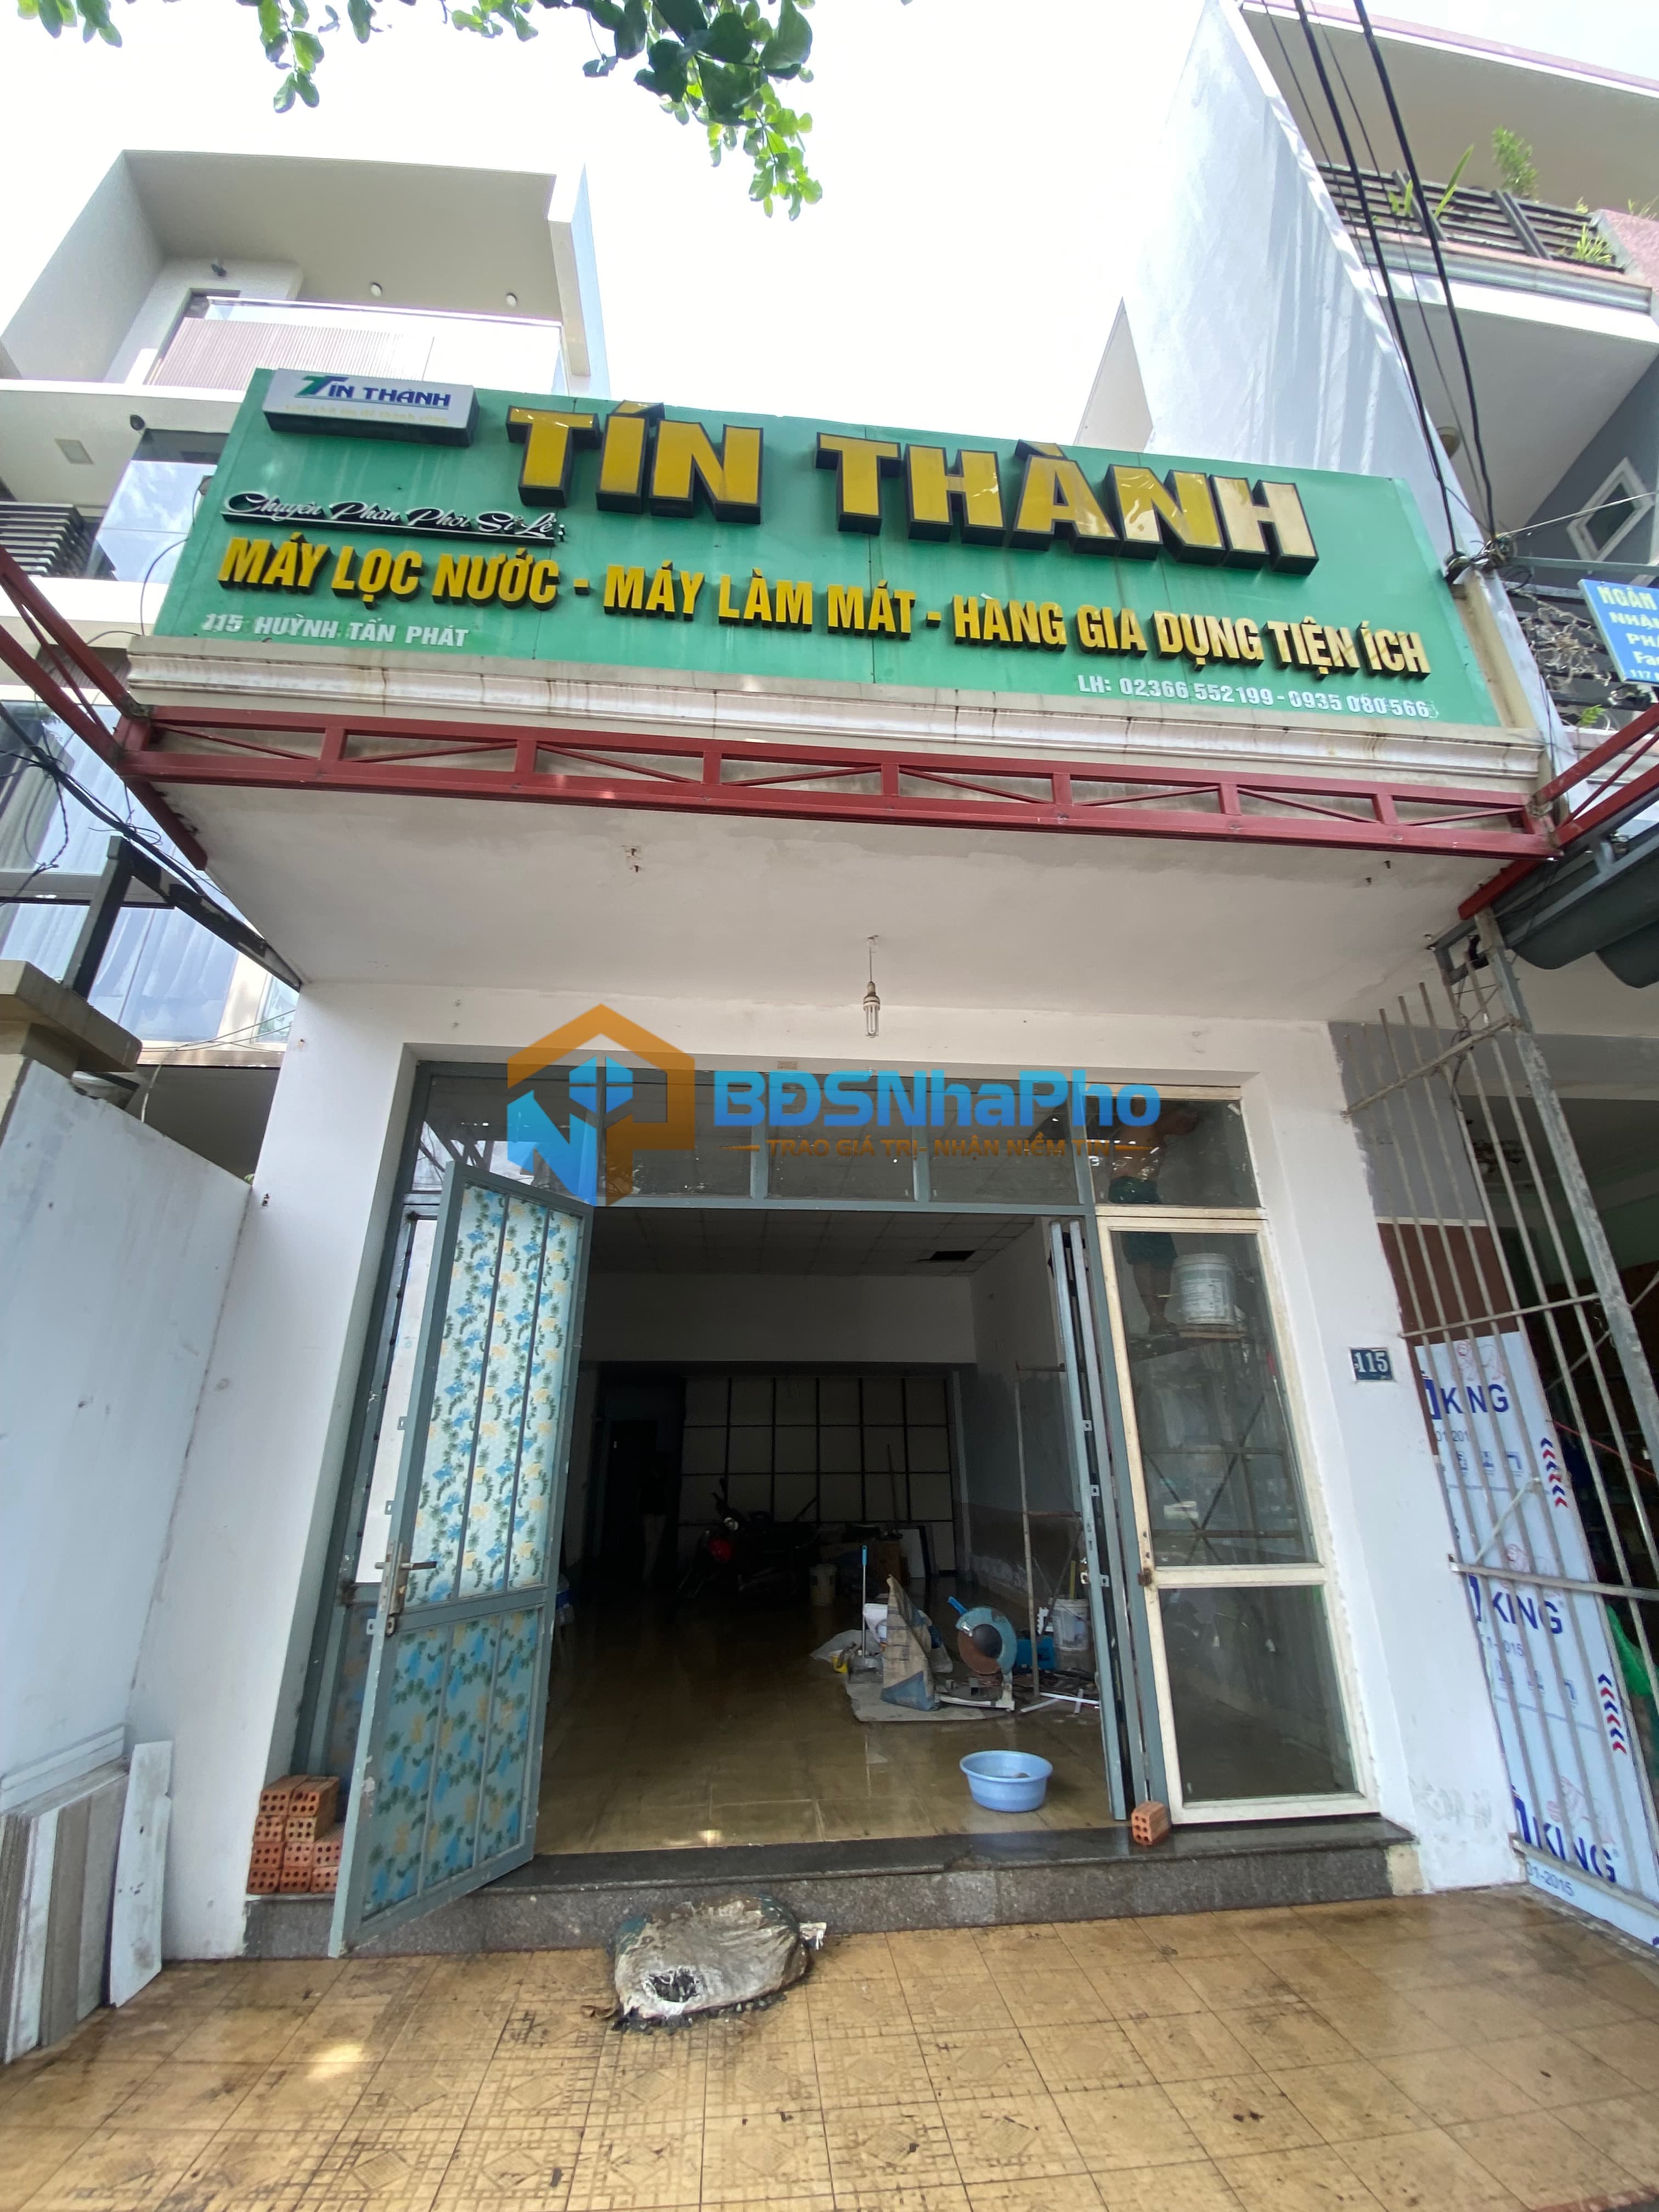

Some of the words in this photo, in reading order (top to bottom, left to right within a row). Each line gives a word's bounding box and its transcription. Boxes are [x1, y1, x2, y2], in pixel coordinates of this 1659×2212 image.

[363, 387, 451, 407] THÀNH
[506, 400, 764, 521] TÍN
[816, 431, 1319, 573] THÀNH
[223, 490, 323, 522] Chuyên
[218, 531, 329, 592] MÁY
[331, 545, 424, 607] LỌC
[431, 547, 560, 608] NƯỚC
[604, 560, 704, 621] MÁY
[718, 568, 812, 631] LÀM
[827, 579, 916, 640] MÁT
[952, 592, 1067, 652] HÀNG
[1076, 604, 1148, 657] GIA
[1152, 610, 1265, 670] DỤNG
[1264, 616, 1361, 679] TIỆN
[1357, 620, 1431, 679] ÍCH
[254, 613, 339, 639] HUỲNH
[349, 617, 397, 642] TẤN
[405, 624, 470, 647] PHÁT
[1077, 675, 1112, 693] LH:
[1119, 678, 1189, 699] 02366
[1288, 690, 1342, 712] 0935
[1354, 1352, 1389, 1373] 115
